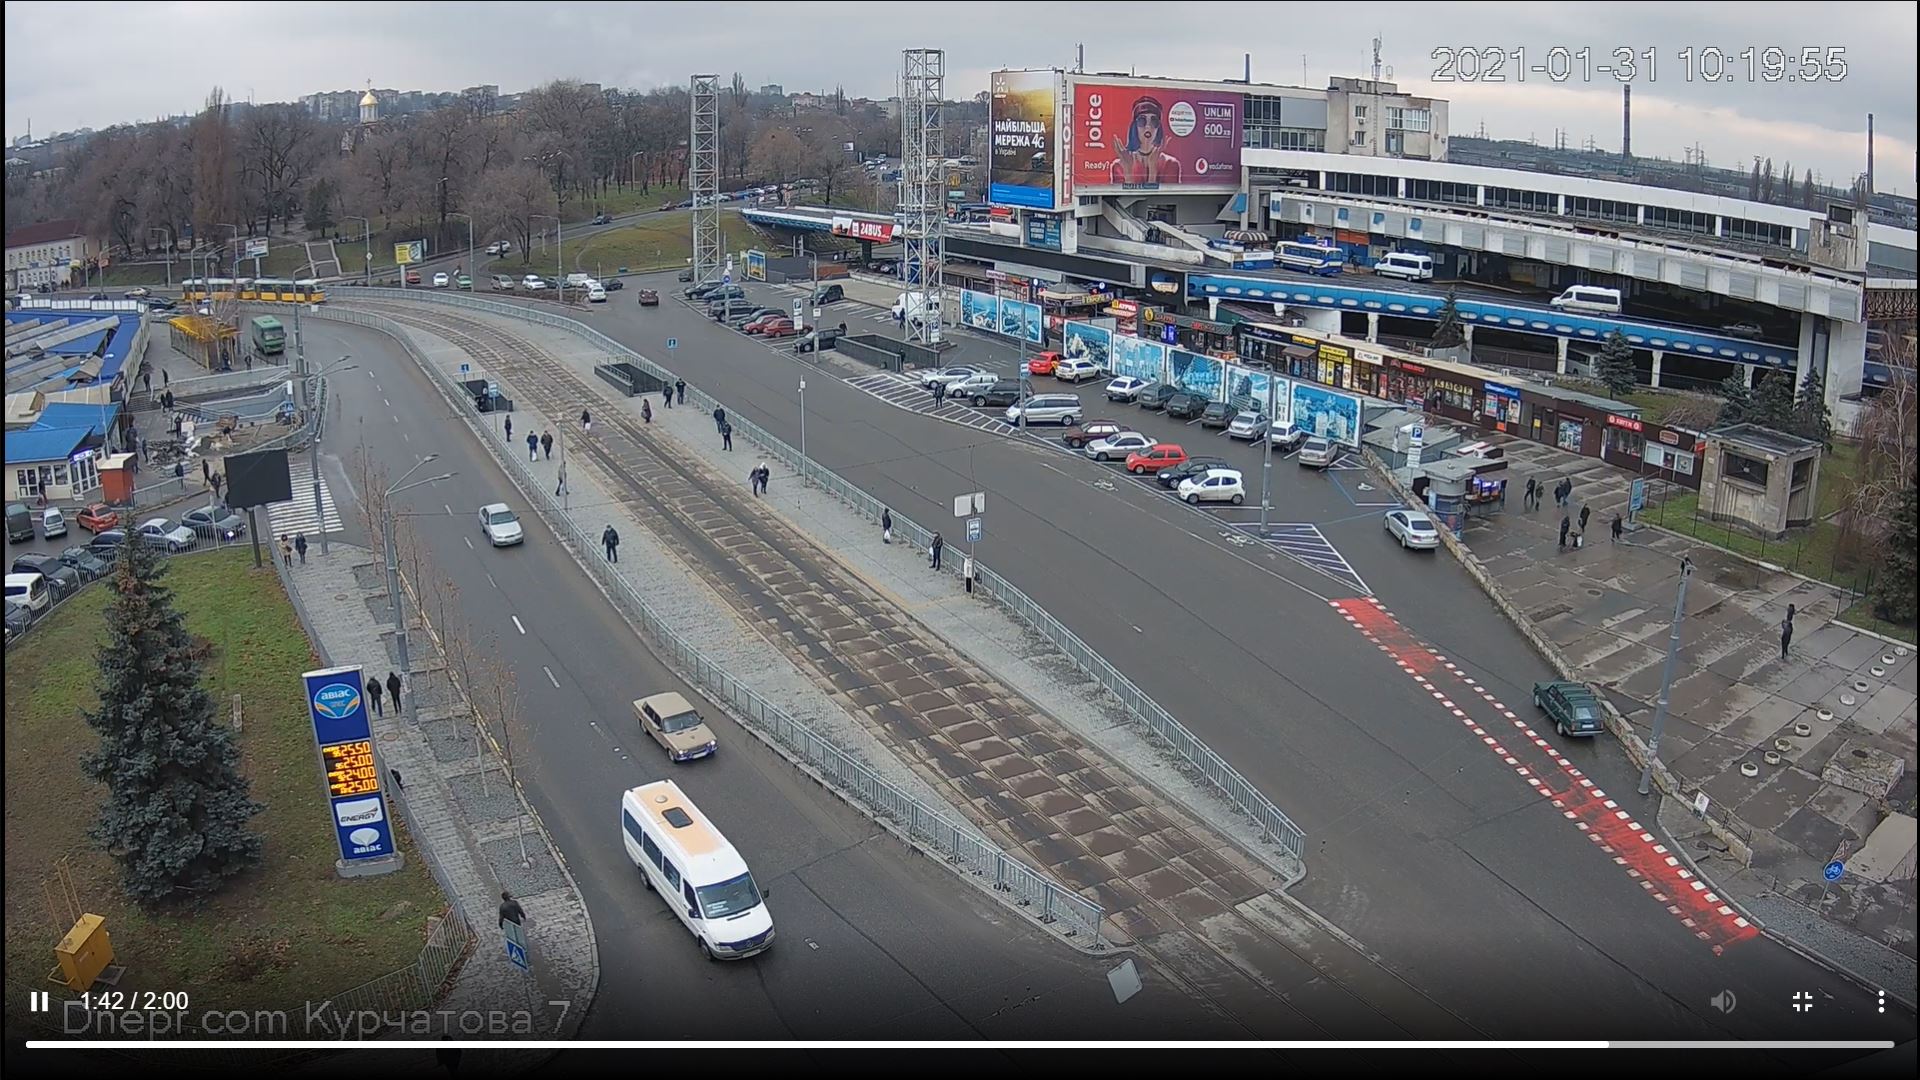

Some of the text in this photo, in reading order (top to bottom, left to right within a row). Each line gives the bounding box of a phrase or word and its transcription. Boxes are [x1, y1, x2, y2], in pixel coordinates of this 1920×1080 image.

[1204, 107, 1231, 118] UNLIM
[995, 119, 1046, 133] НАЙБІЛЬША
[1085, 94, 1104, 148] joice
[1204, 123, 1223, 135] 600
[995, 134, 1045, 148] МЕРЕЖА 4G
[1062, 107, 1072, 199] HOTEL
[1085, 161, 1109, 171] Ready?
[860, 223, 882, 236] 24BUS
[340, 808, 377, 822] ENERGY
